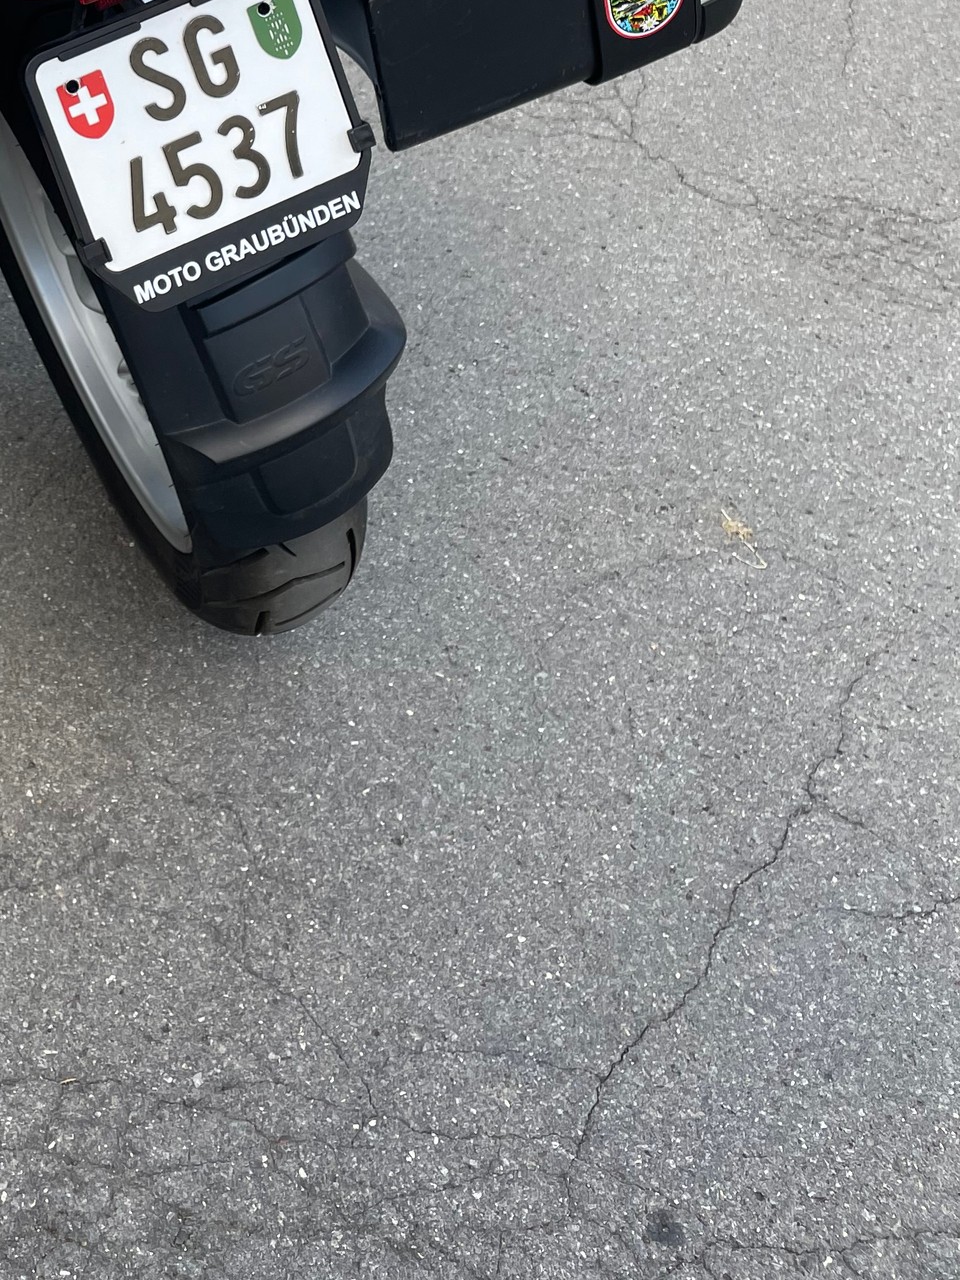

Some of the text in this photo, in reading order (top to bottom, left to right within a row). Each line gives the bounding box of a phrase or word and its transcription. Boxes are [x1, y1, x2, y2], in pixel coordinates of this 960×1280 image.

[130, 14, 241, 122] SG
[130, 90, 304, 235] 4537
[133, 190, 361, 304] MOTO GRAUBÜNDEN
